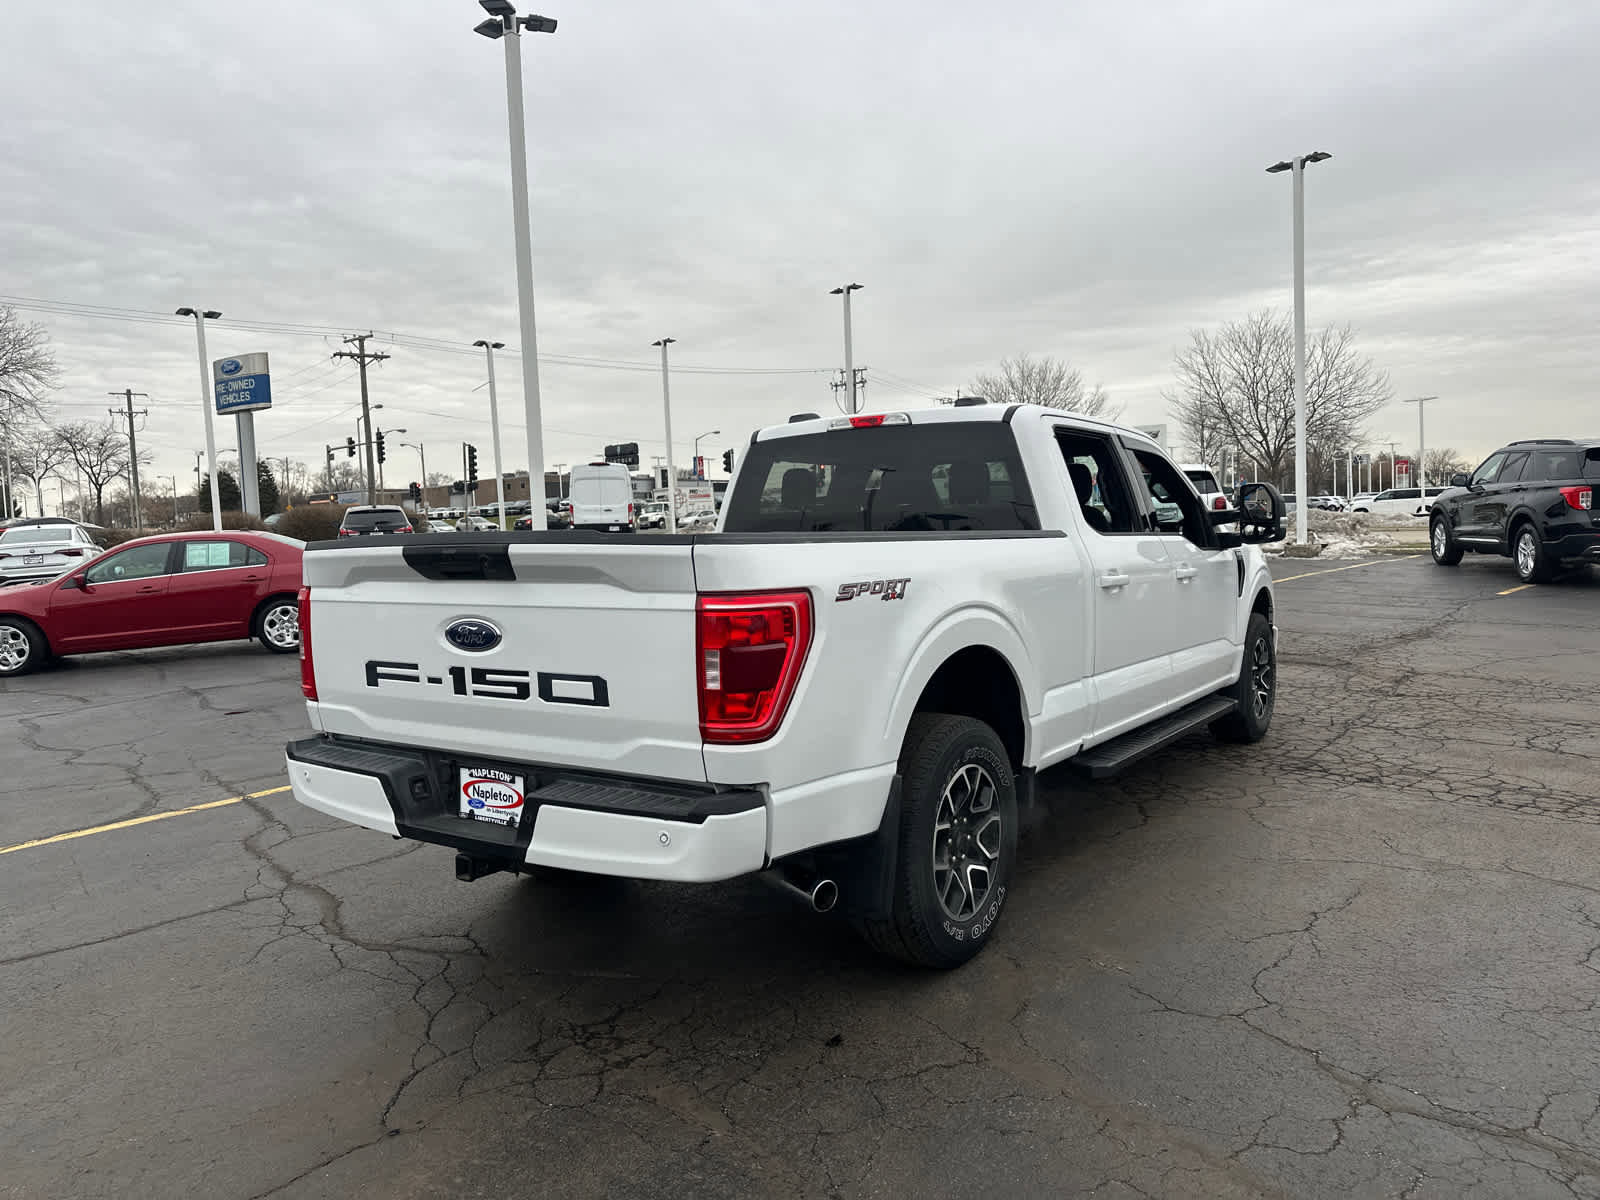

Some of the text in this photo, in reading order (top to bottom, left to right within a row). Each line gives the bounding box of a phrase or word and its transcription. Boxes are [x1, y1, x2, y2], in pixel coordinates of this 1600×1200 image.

[835, 577, 911, 602] SPORT
[455, 624, 488, 646] Ford
[365, 660, 609, 707] F-150
[472, 784, 513, 803] Napleton
[971, 886, 1006, 939] TOYO
